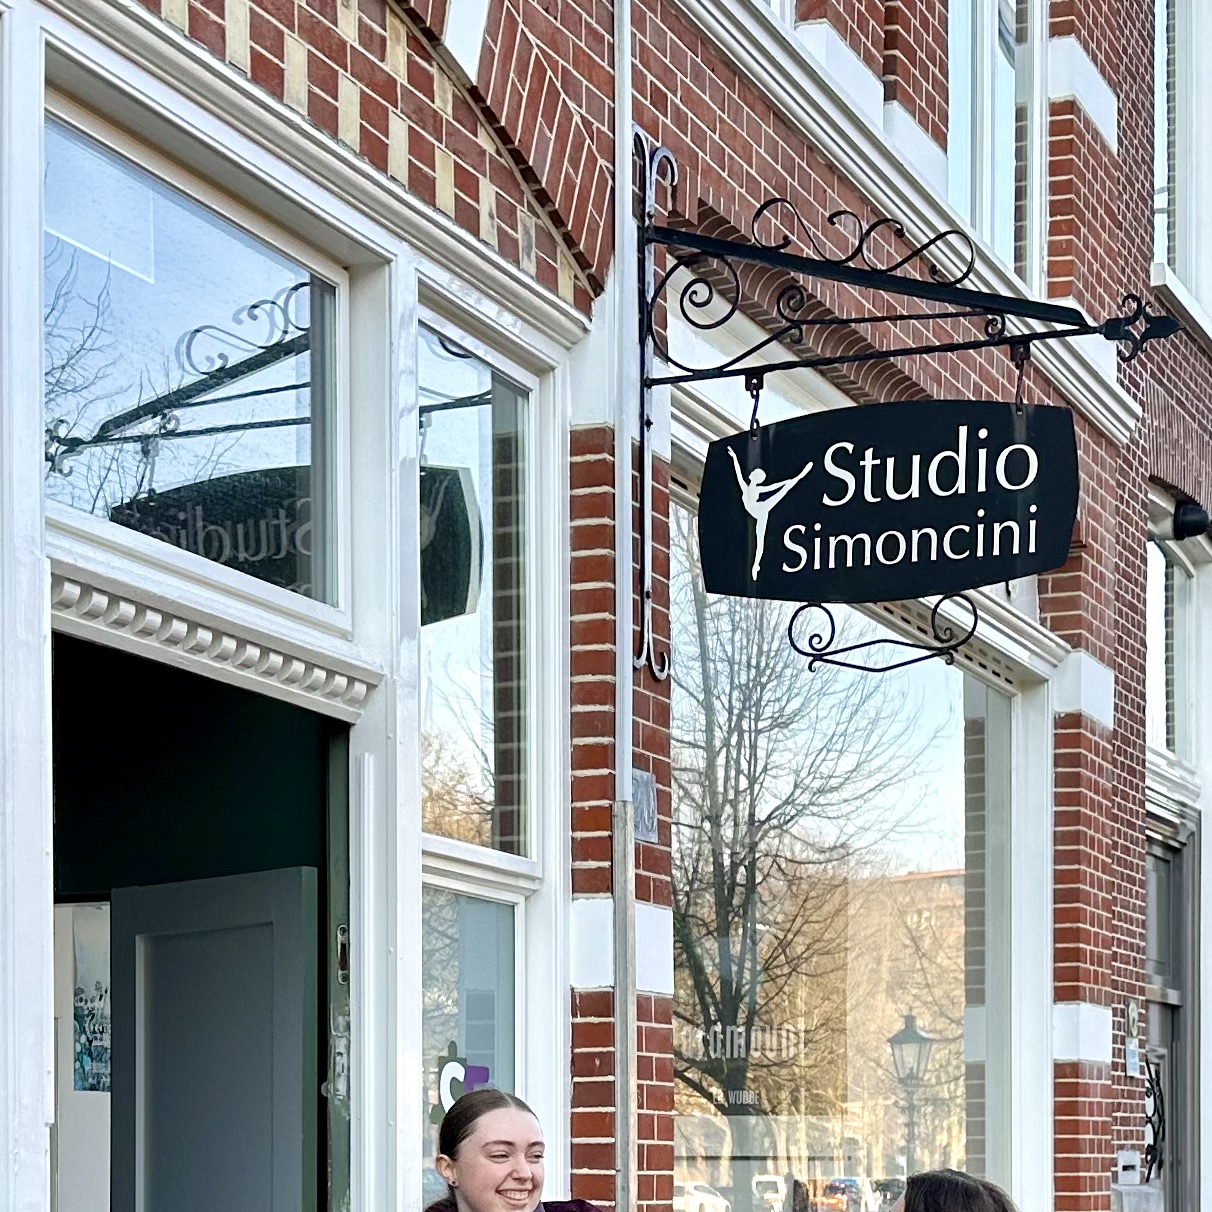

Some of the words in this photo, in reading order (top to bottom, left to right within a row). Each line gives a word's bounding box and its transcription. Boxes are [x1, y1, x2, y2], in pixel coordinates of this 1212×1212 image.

[821, 425, 1039, 507] Studio
[781, 505, 1038, 573] Simoncini
[728, 1089, 760, 1105] WUBBE
